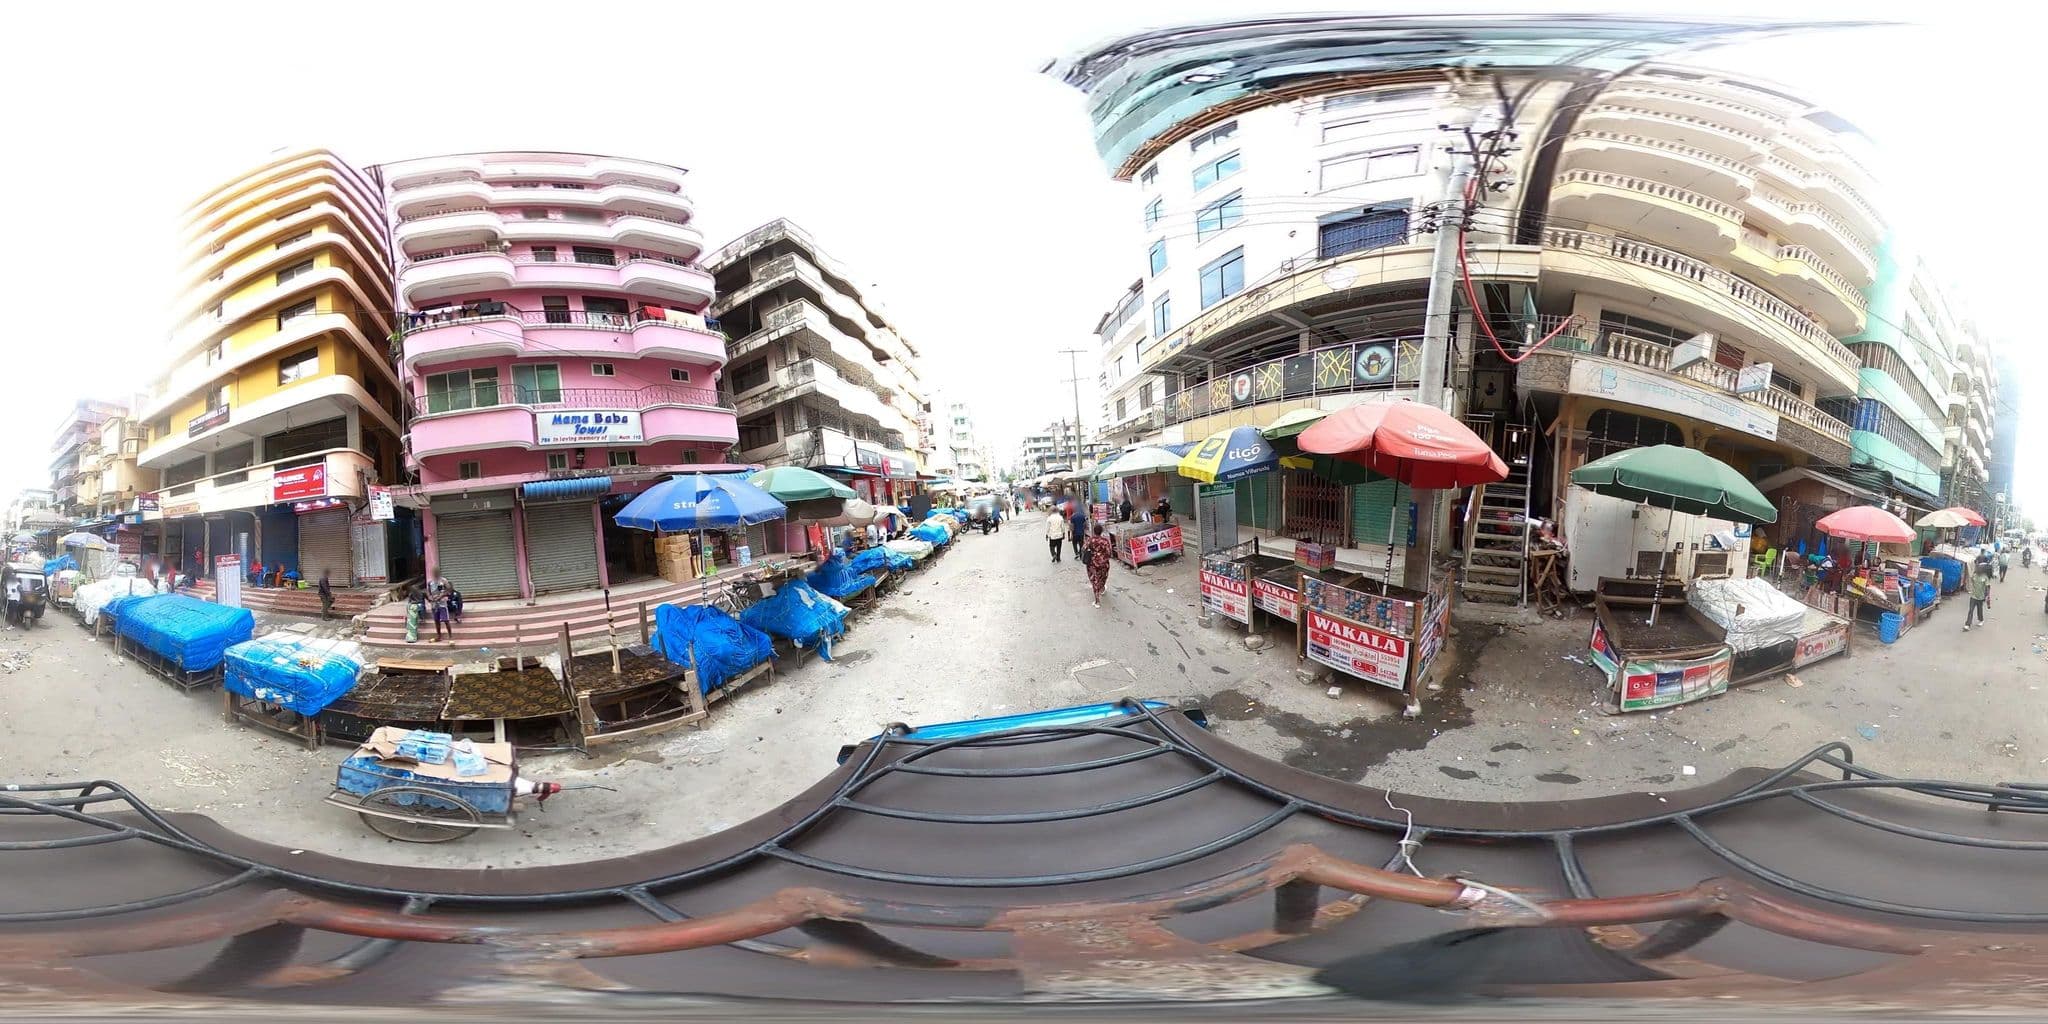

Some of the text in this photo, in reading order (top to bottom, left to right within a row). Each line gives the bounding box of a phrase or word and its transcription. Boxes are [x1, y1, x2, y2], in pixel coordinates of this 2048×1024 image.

[552, 413, 628, 425] Mama Baba
[574, 423, 608, 435] Tower
[1202, 572, 1243, 594] WAKALA
[1254, 580, 1297, 602] WAKAL
[1313, 615, 1398, 653] WAKALA
